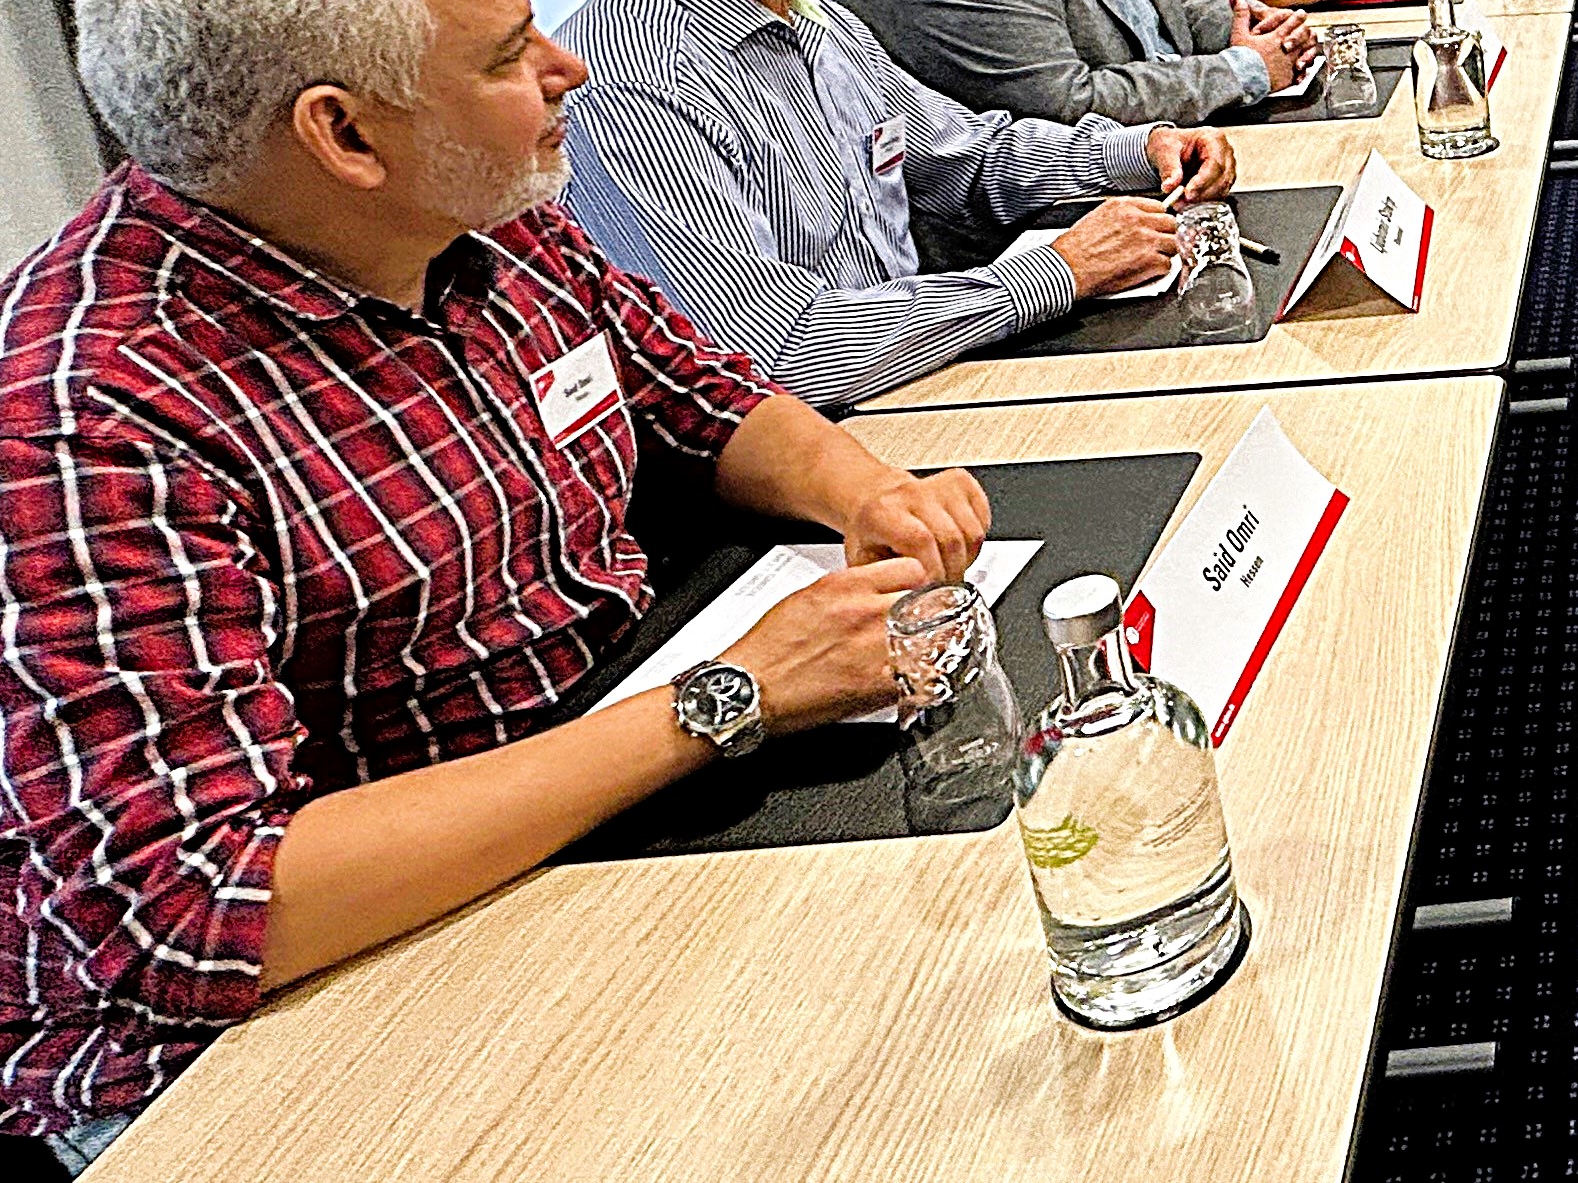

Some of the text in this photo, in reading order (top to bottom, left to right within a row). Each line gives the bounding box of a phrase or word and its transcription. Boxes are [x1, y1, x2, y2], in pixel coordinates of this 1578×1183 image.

[1202, 504, 1260, 592] Said Omri
[1239, 555, 1264, 588] Hessen
